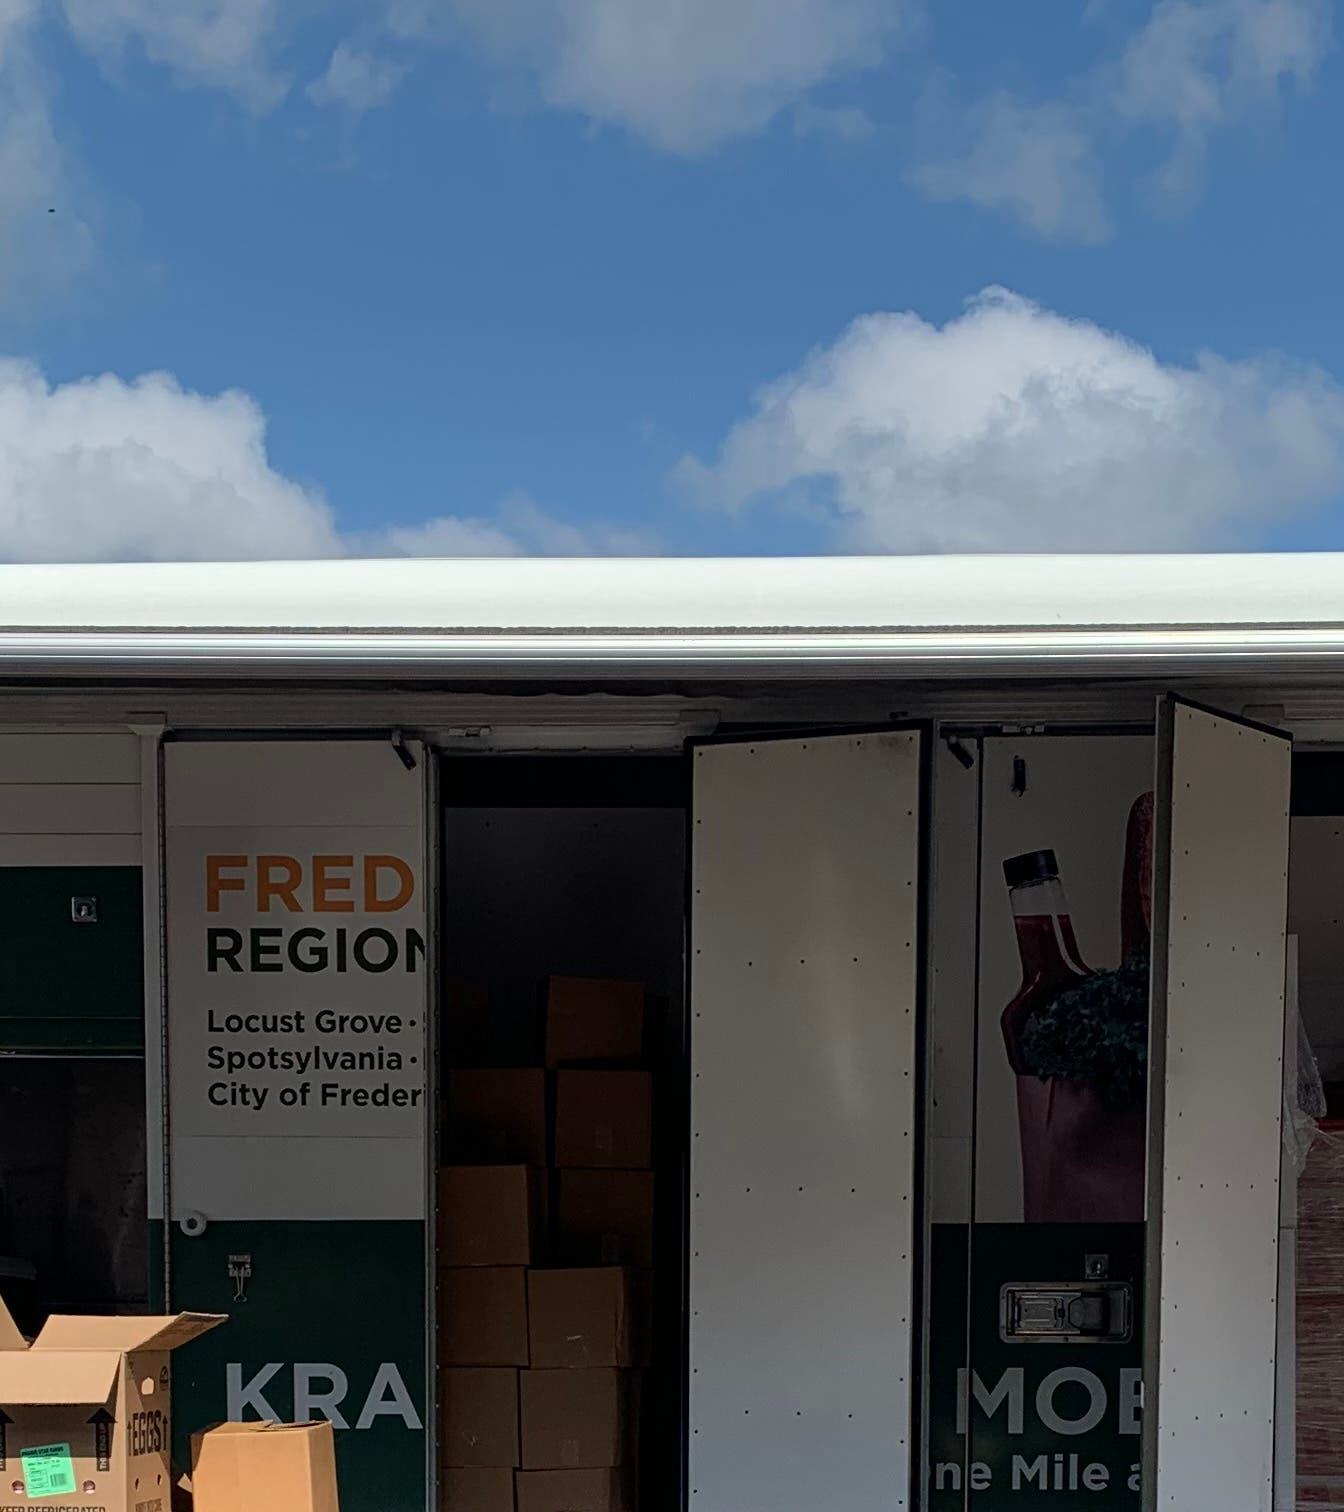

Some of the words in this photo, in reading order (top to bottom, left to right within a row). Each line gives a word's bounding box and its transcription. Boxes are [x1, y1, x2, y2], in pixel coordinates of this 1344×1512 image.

[206, 855, 424, 912] FRED
[207, 1009, 305, 1034] Locust
[315, 1009, 402, 1034] Grove
[207, 1046, 402, 1074] Spotsylvania
[207, 1082, 268, 1110] City
[279, 1082, 311, 1106] of
[321, 1082, 425, 1107] Freder
[226, 1362, 423, 1429] KRA
[132, 1410, 162, 1456] EGGS
[930, 1460, 992, 1490] ne
[1011, 1453, 1110, 1490] Mile
